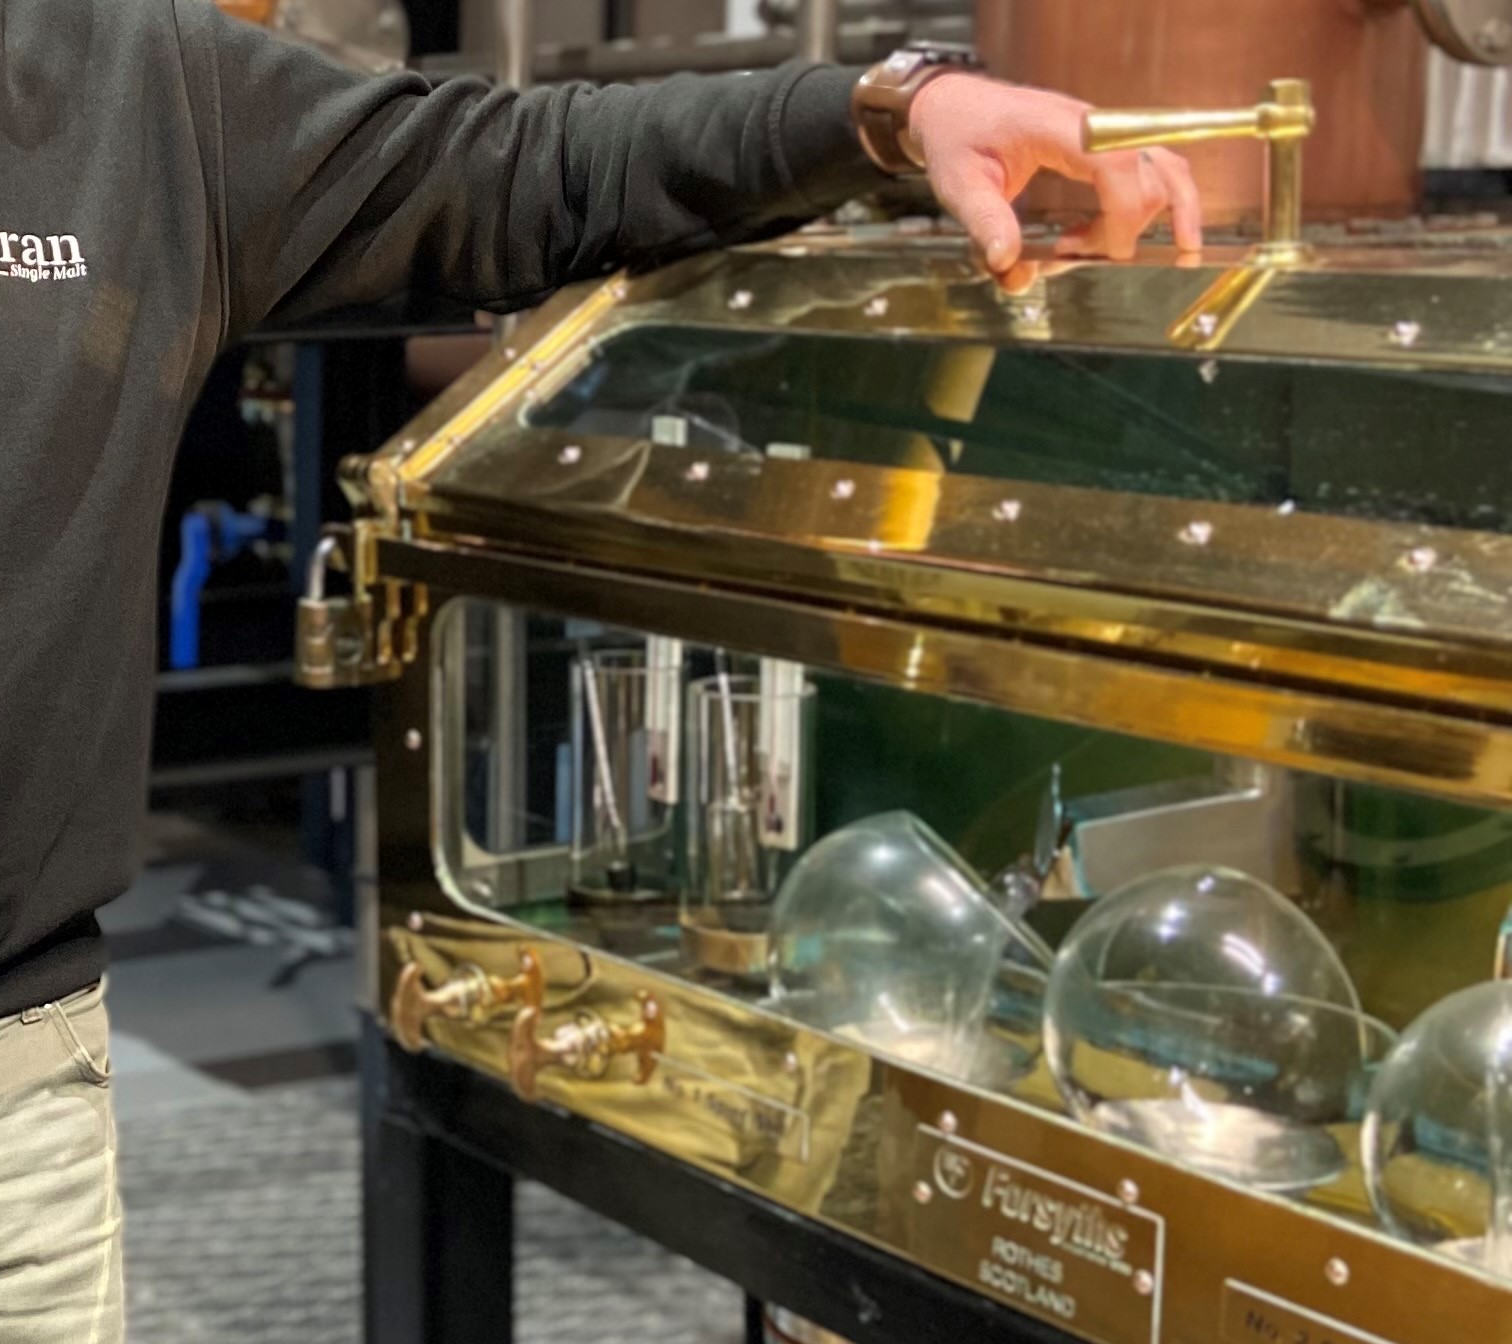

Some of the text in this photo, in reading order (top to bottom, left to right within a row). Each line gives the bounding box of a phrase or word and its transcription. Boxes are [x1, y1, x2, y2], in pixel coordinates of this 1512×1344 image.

[9, 263, 87, 283] Single Malt
[978, 1258, 1077, 1320] SCOTLAND
